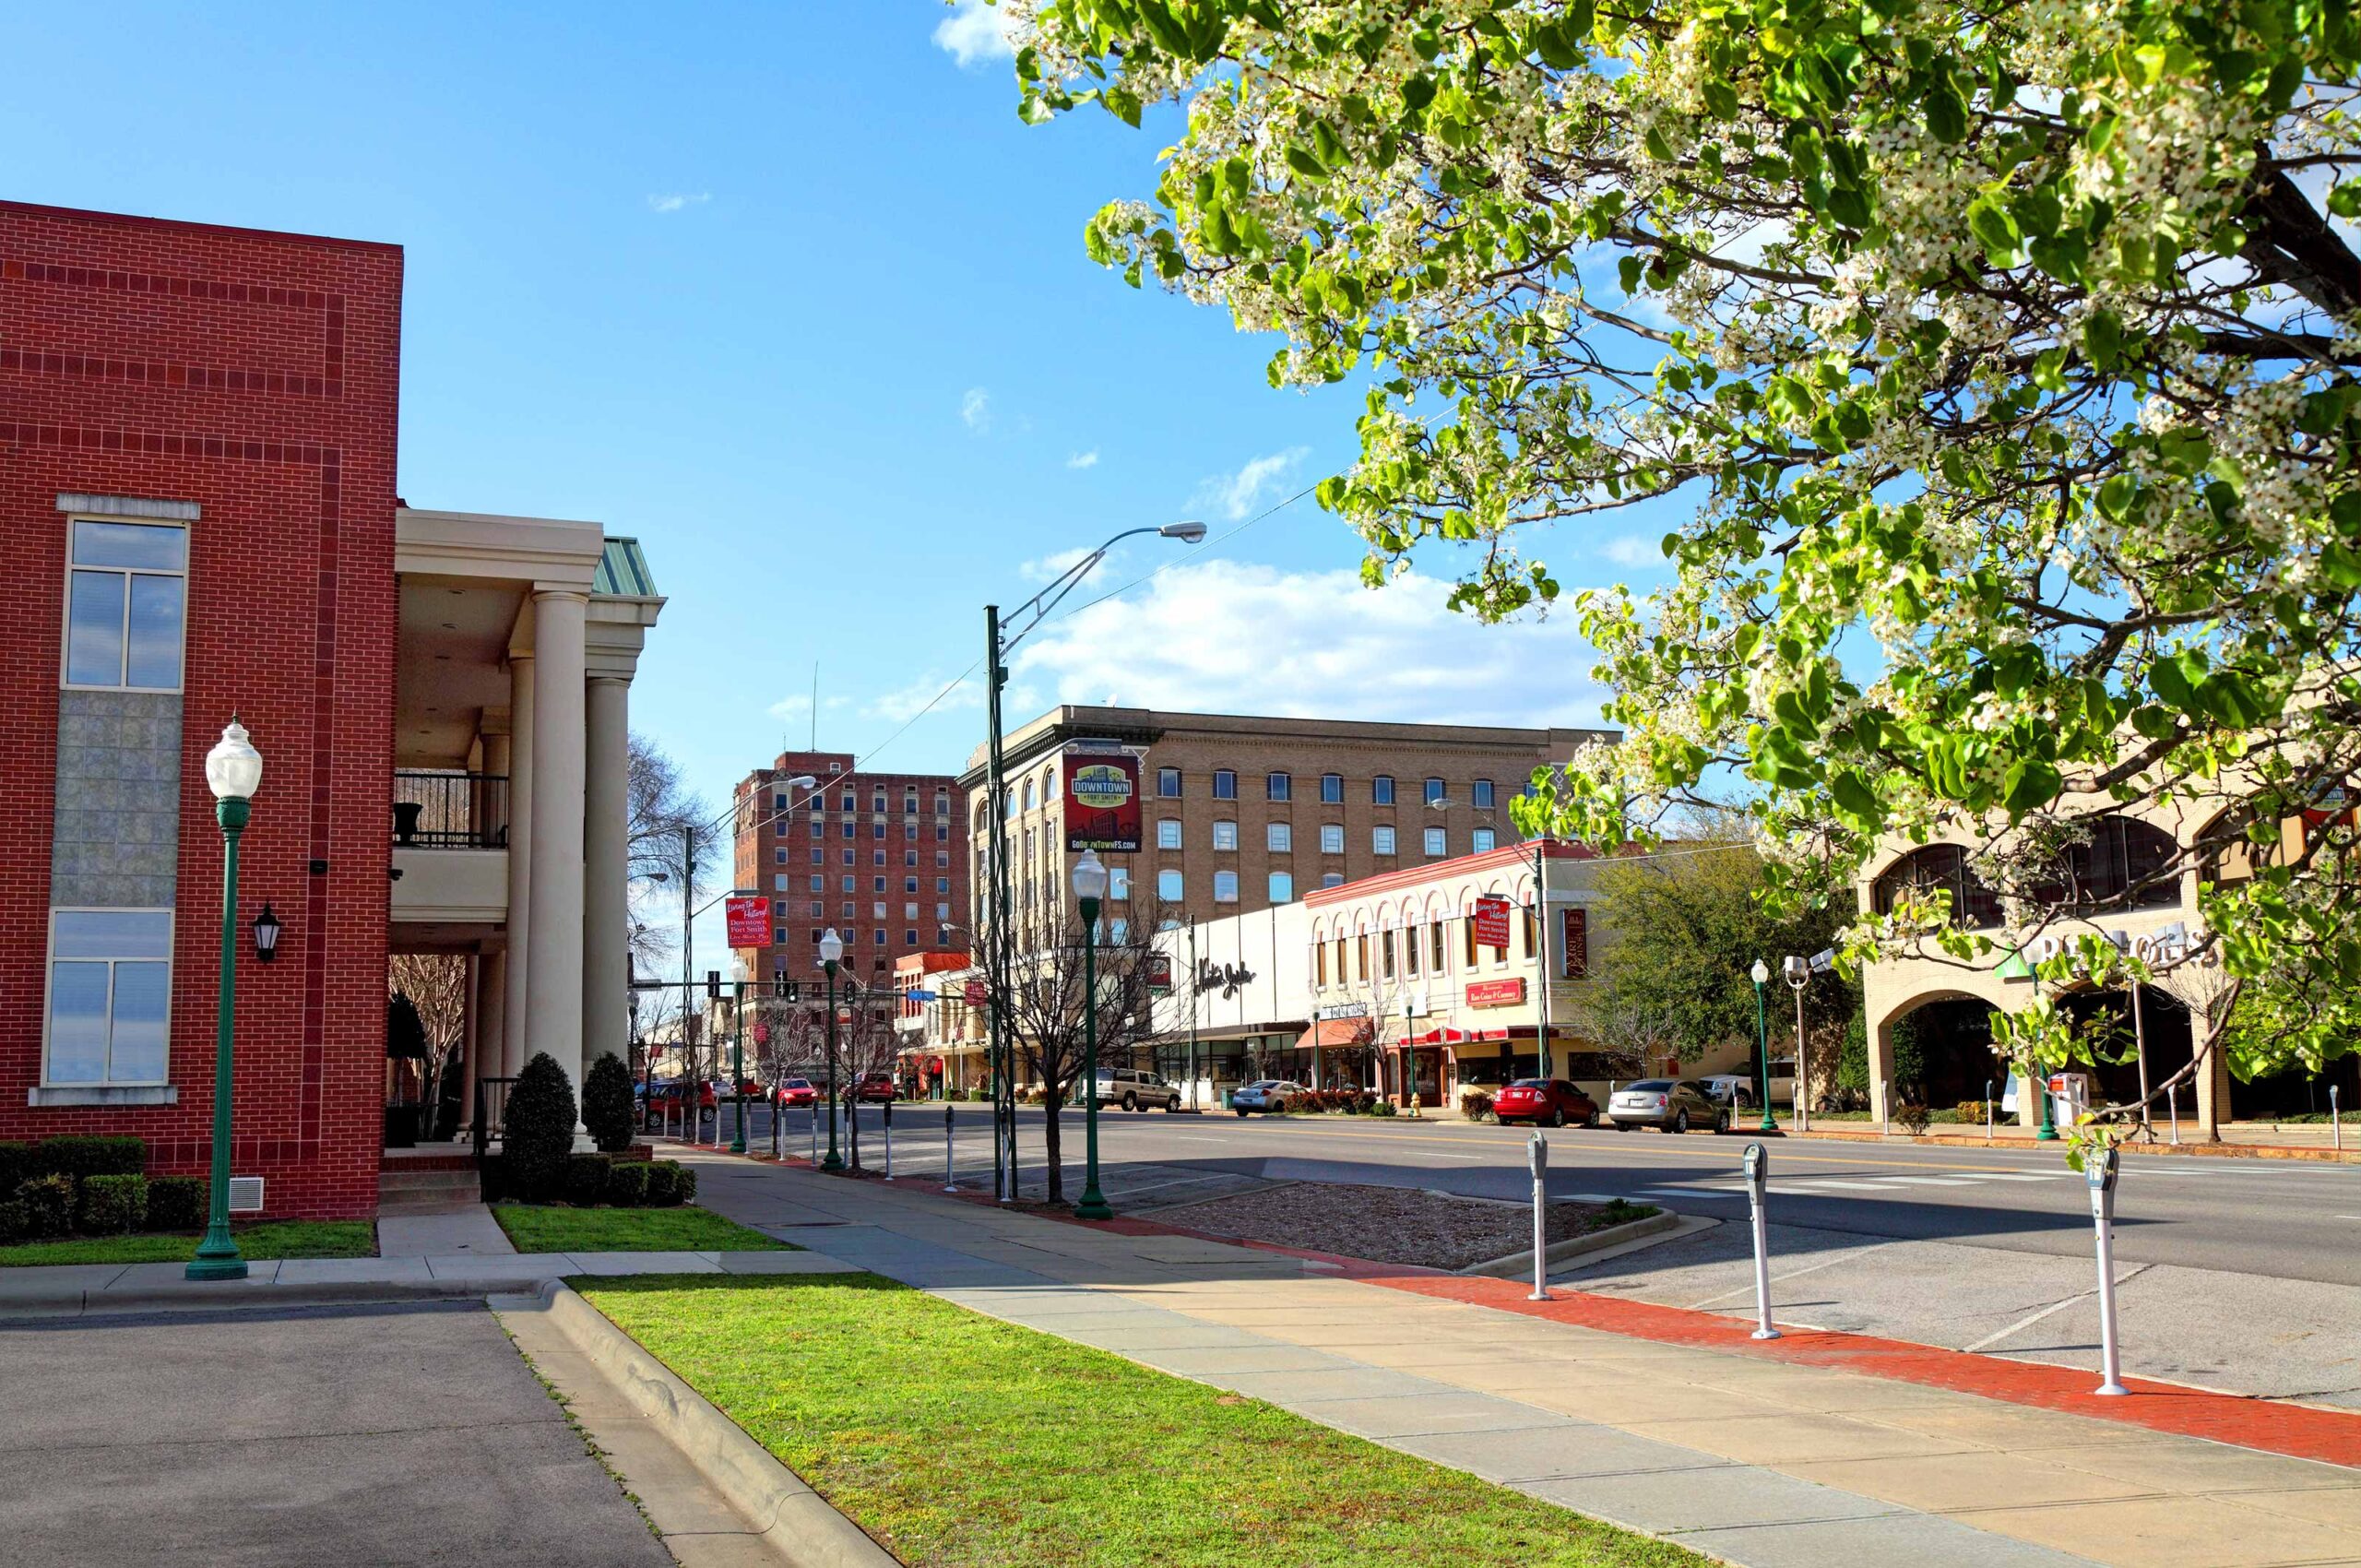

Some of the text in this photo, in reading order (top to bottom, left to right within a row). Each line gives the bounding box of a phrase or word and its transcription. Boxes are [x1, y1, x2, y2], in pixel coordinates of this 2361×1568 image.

[1074, 781, 1129, 792] DOWNTOWN
[728, 899, 754, 912] Living the
[1477, 903, 1491, 911] Living
[743, 905, 767, 919] History!
[1480, 992, 1493, 1000] Coins
